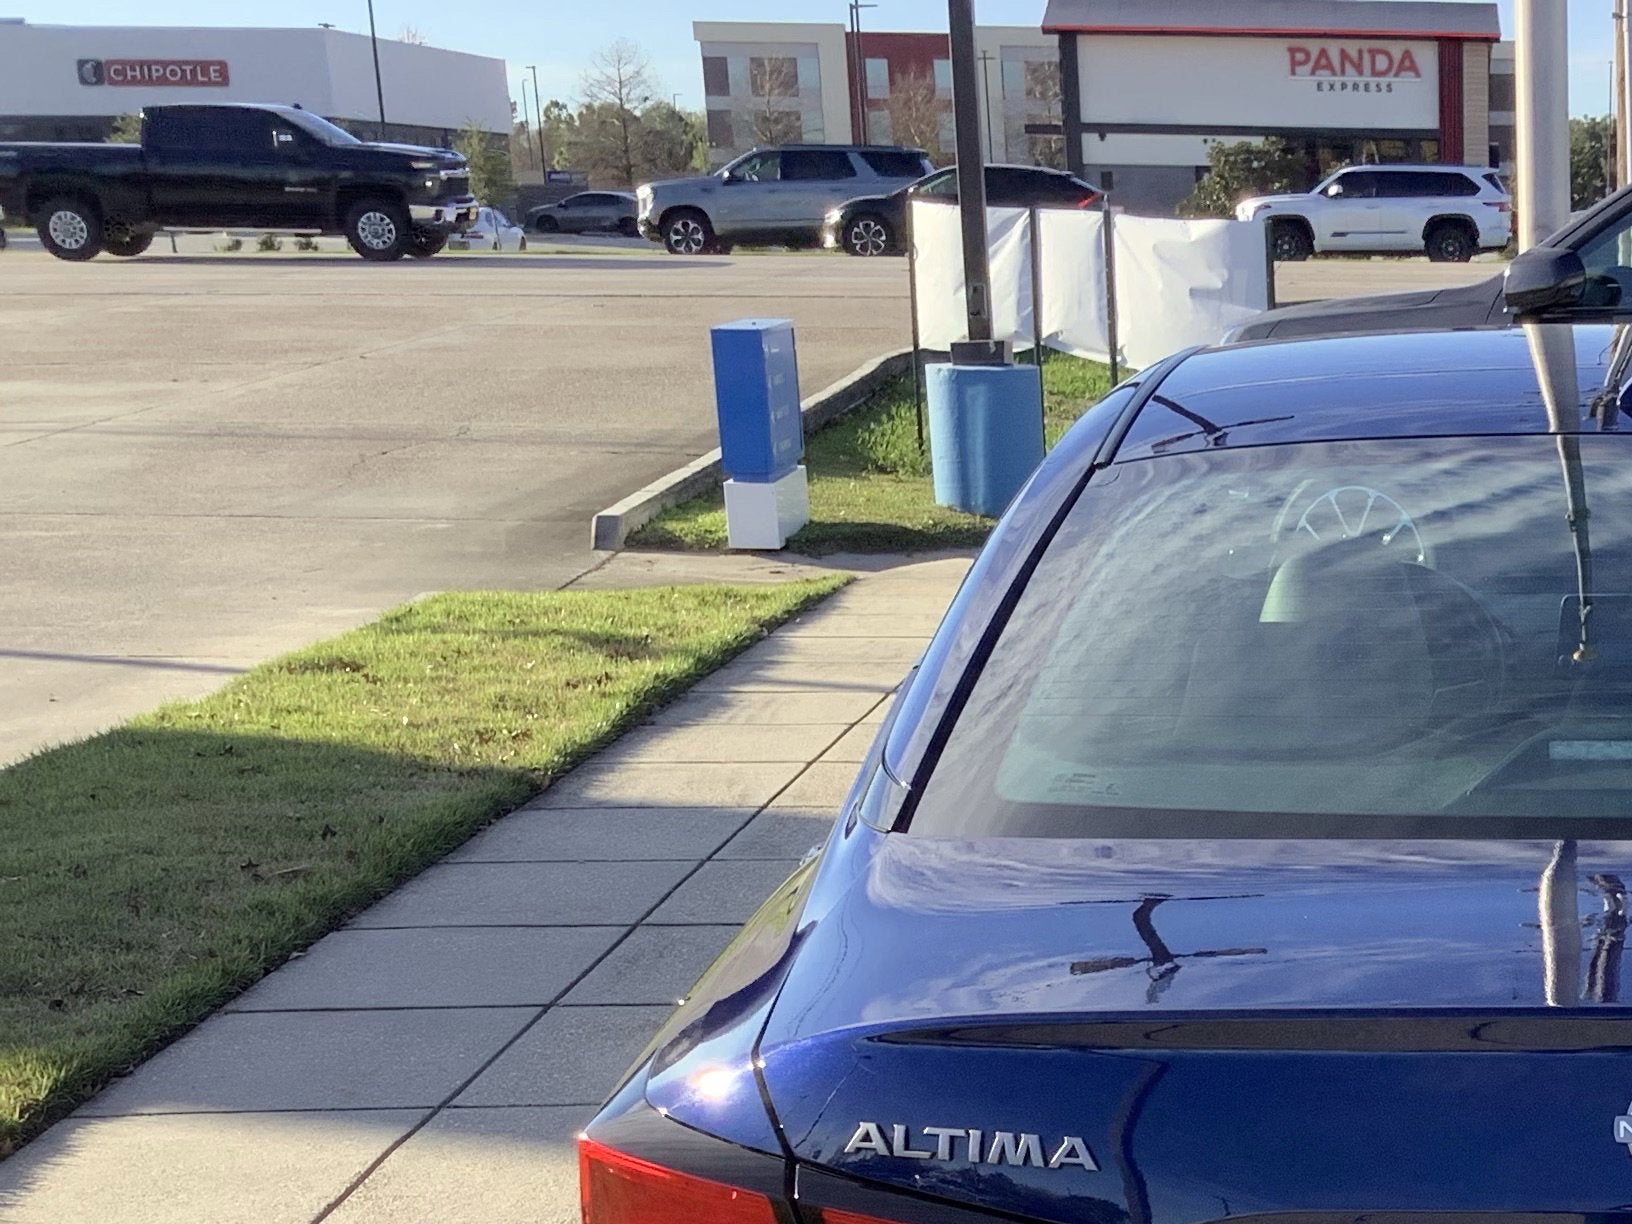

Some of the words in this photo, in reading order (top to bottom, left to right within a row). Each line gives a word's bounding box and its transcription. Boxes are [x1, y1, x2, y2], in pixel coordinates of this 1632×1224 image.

[110, 64, 223, 81] CHIPOTLE
[1287, 47, 1422, 78] PANDA
[1316, 81, 1393, 93] EXPRESS
[844, 1121, 1098, 1171] ALTIMA
